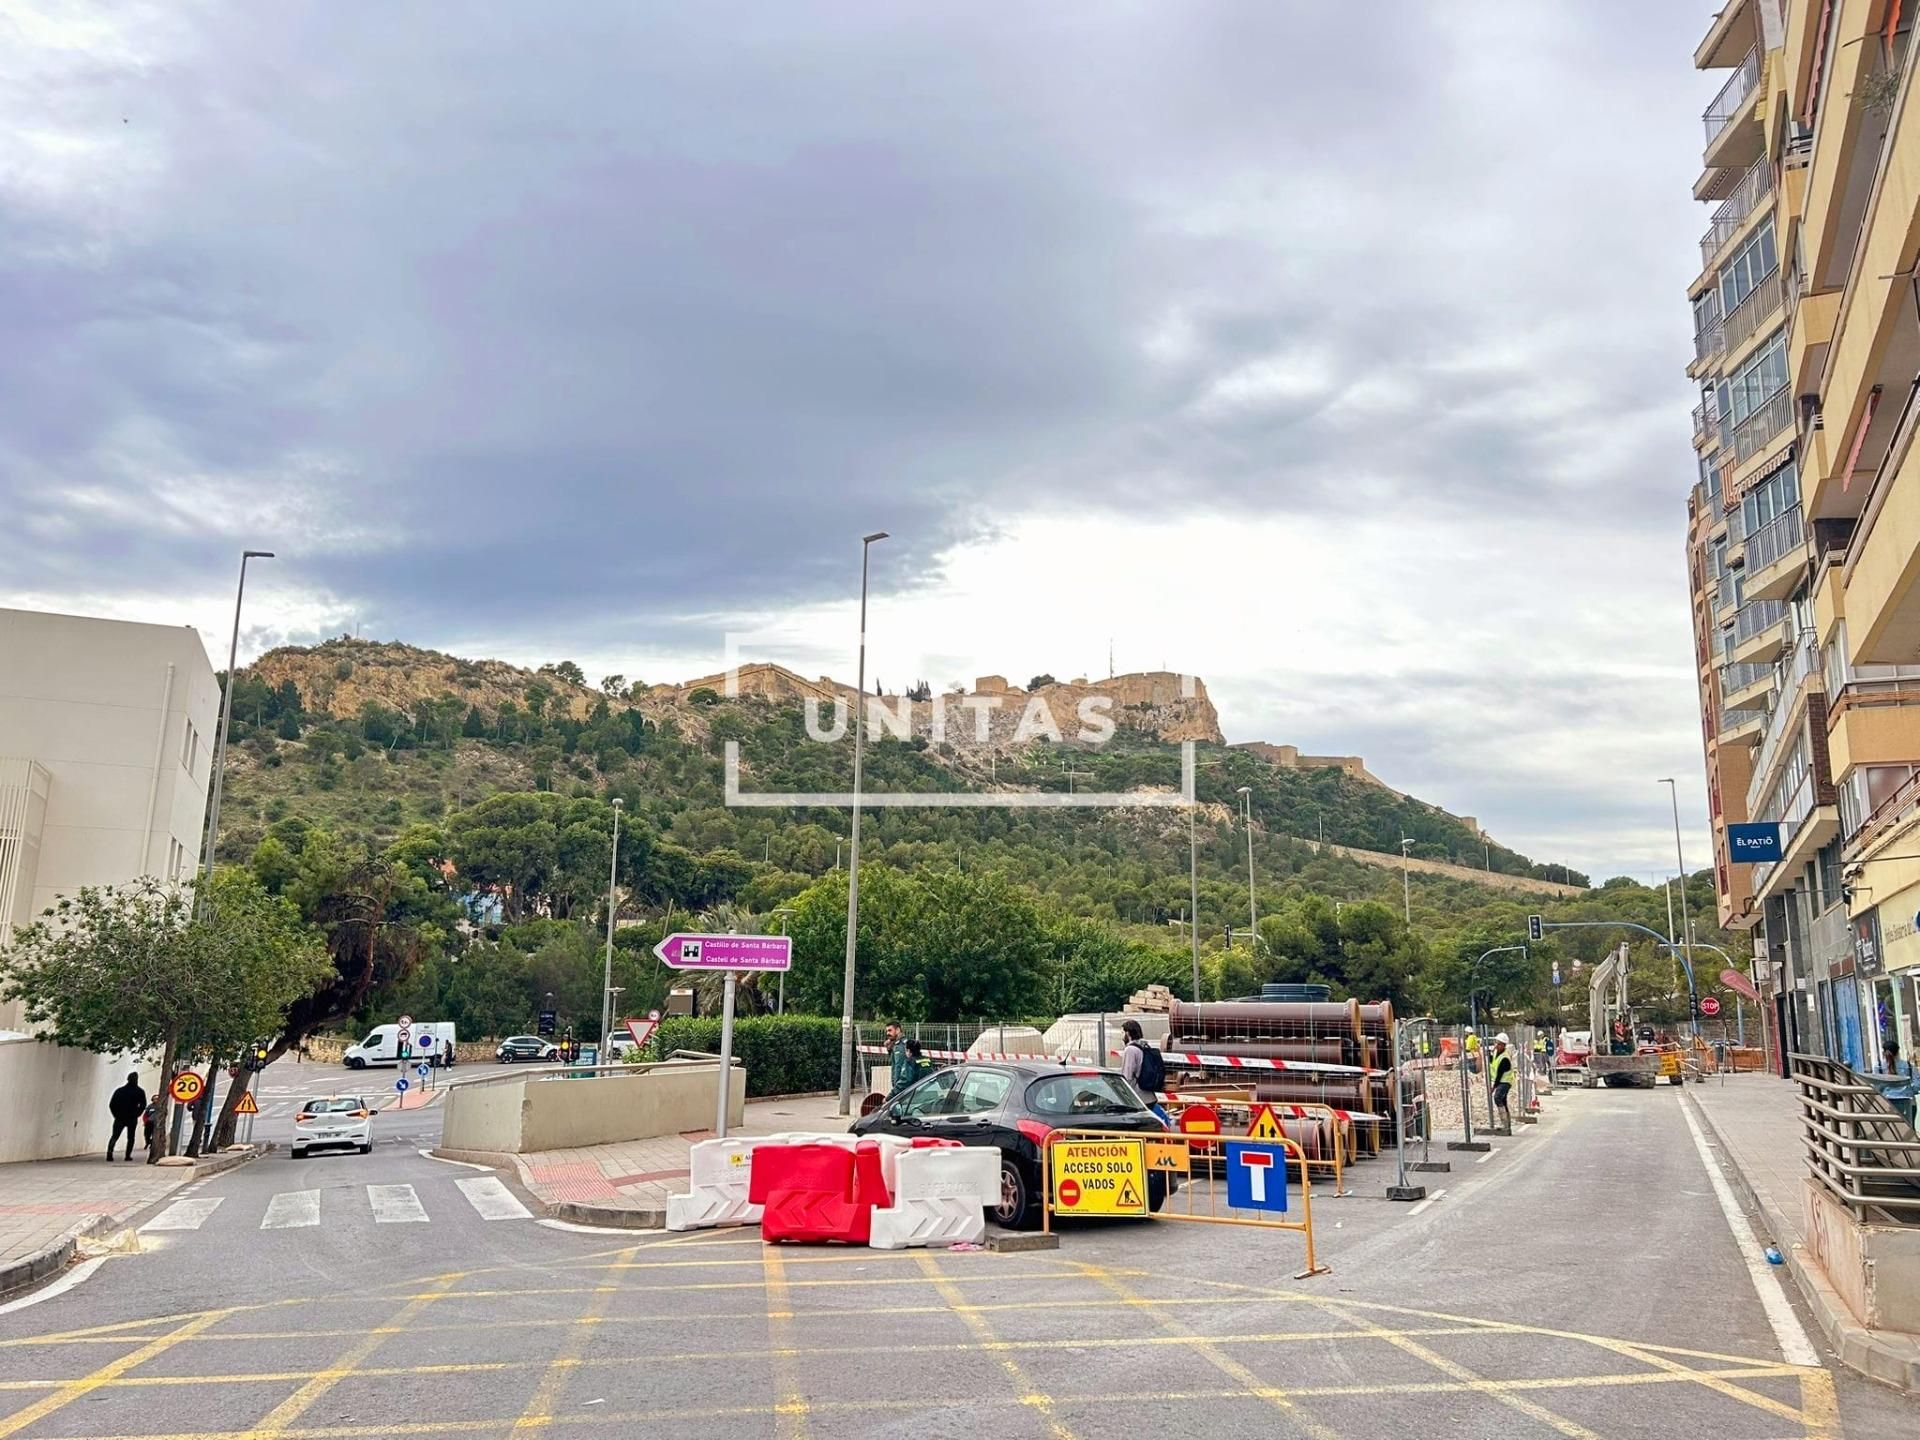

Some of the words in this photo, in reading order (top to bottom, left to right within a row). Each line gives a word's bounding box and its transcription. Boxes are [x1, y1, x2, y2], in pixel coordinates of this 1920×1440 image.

[705, 940, 729, 949] Castillo
[730, 941, 739, 949] de
[741, 941, 759, 949] Santa
[706, 955, 729, 963] Castell
[740, 956, 759, 964] Santa
[1703, 1002, 1718, 1010] STOP
[177, 1081, 198, 1093] 20
[1067, 1144, 1128, 1158] ATENCIÓN
[1064, 1162, 1103, 1174] ACCESO
[1107, 1162, 1133, 1173] SOLO
[1083, 1178, 1116, 1190] VADOS
